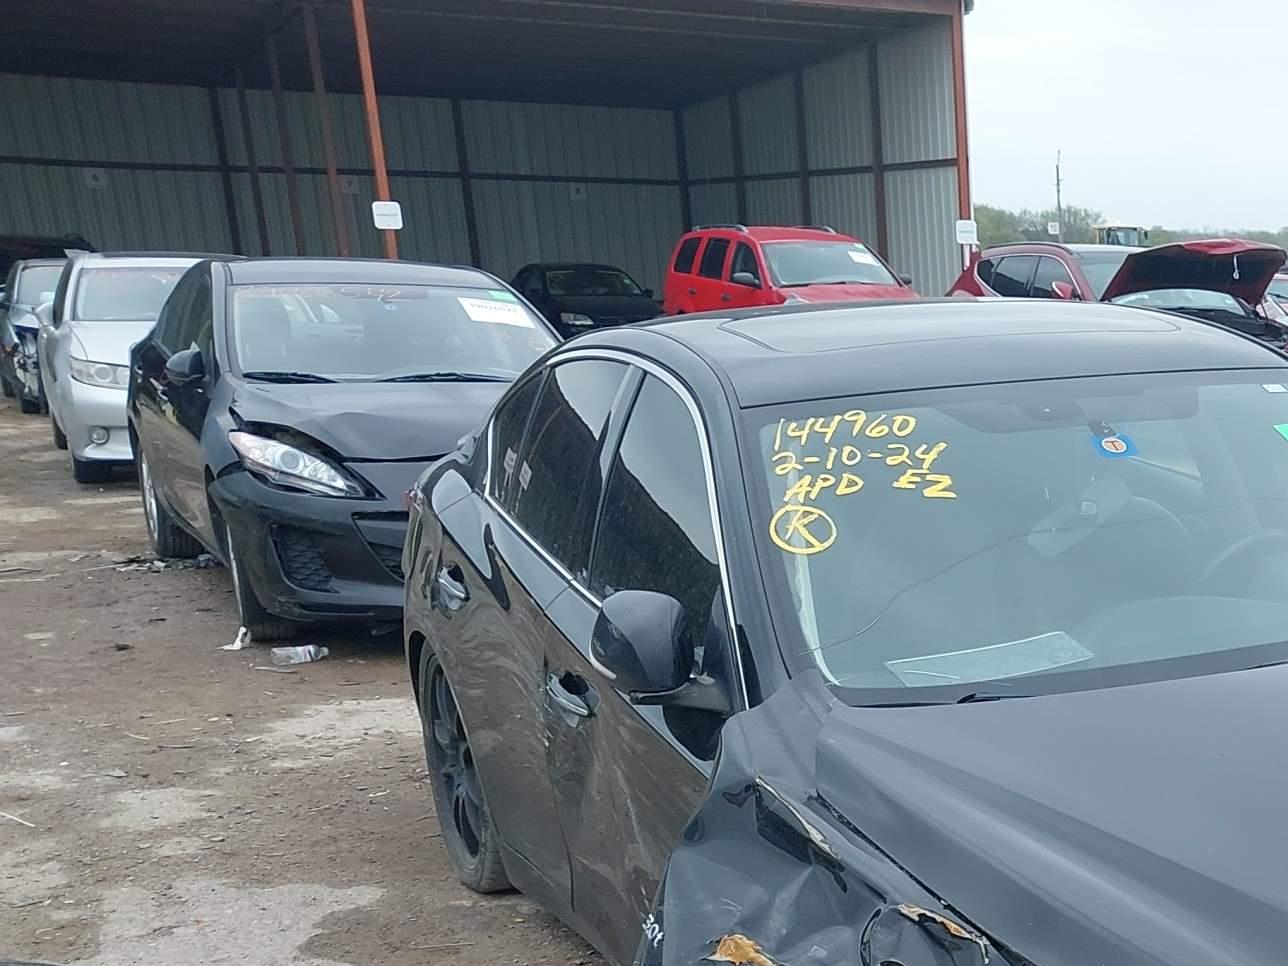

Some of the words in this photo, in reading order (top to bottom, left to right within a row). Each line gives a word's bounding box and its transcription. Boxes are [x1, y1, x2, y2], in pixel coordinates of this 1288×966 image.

[774, 410, 916, 452] 144960
[772, 441, 948, 475] 2-10-24
[784, 471, 864, 503] APD
